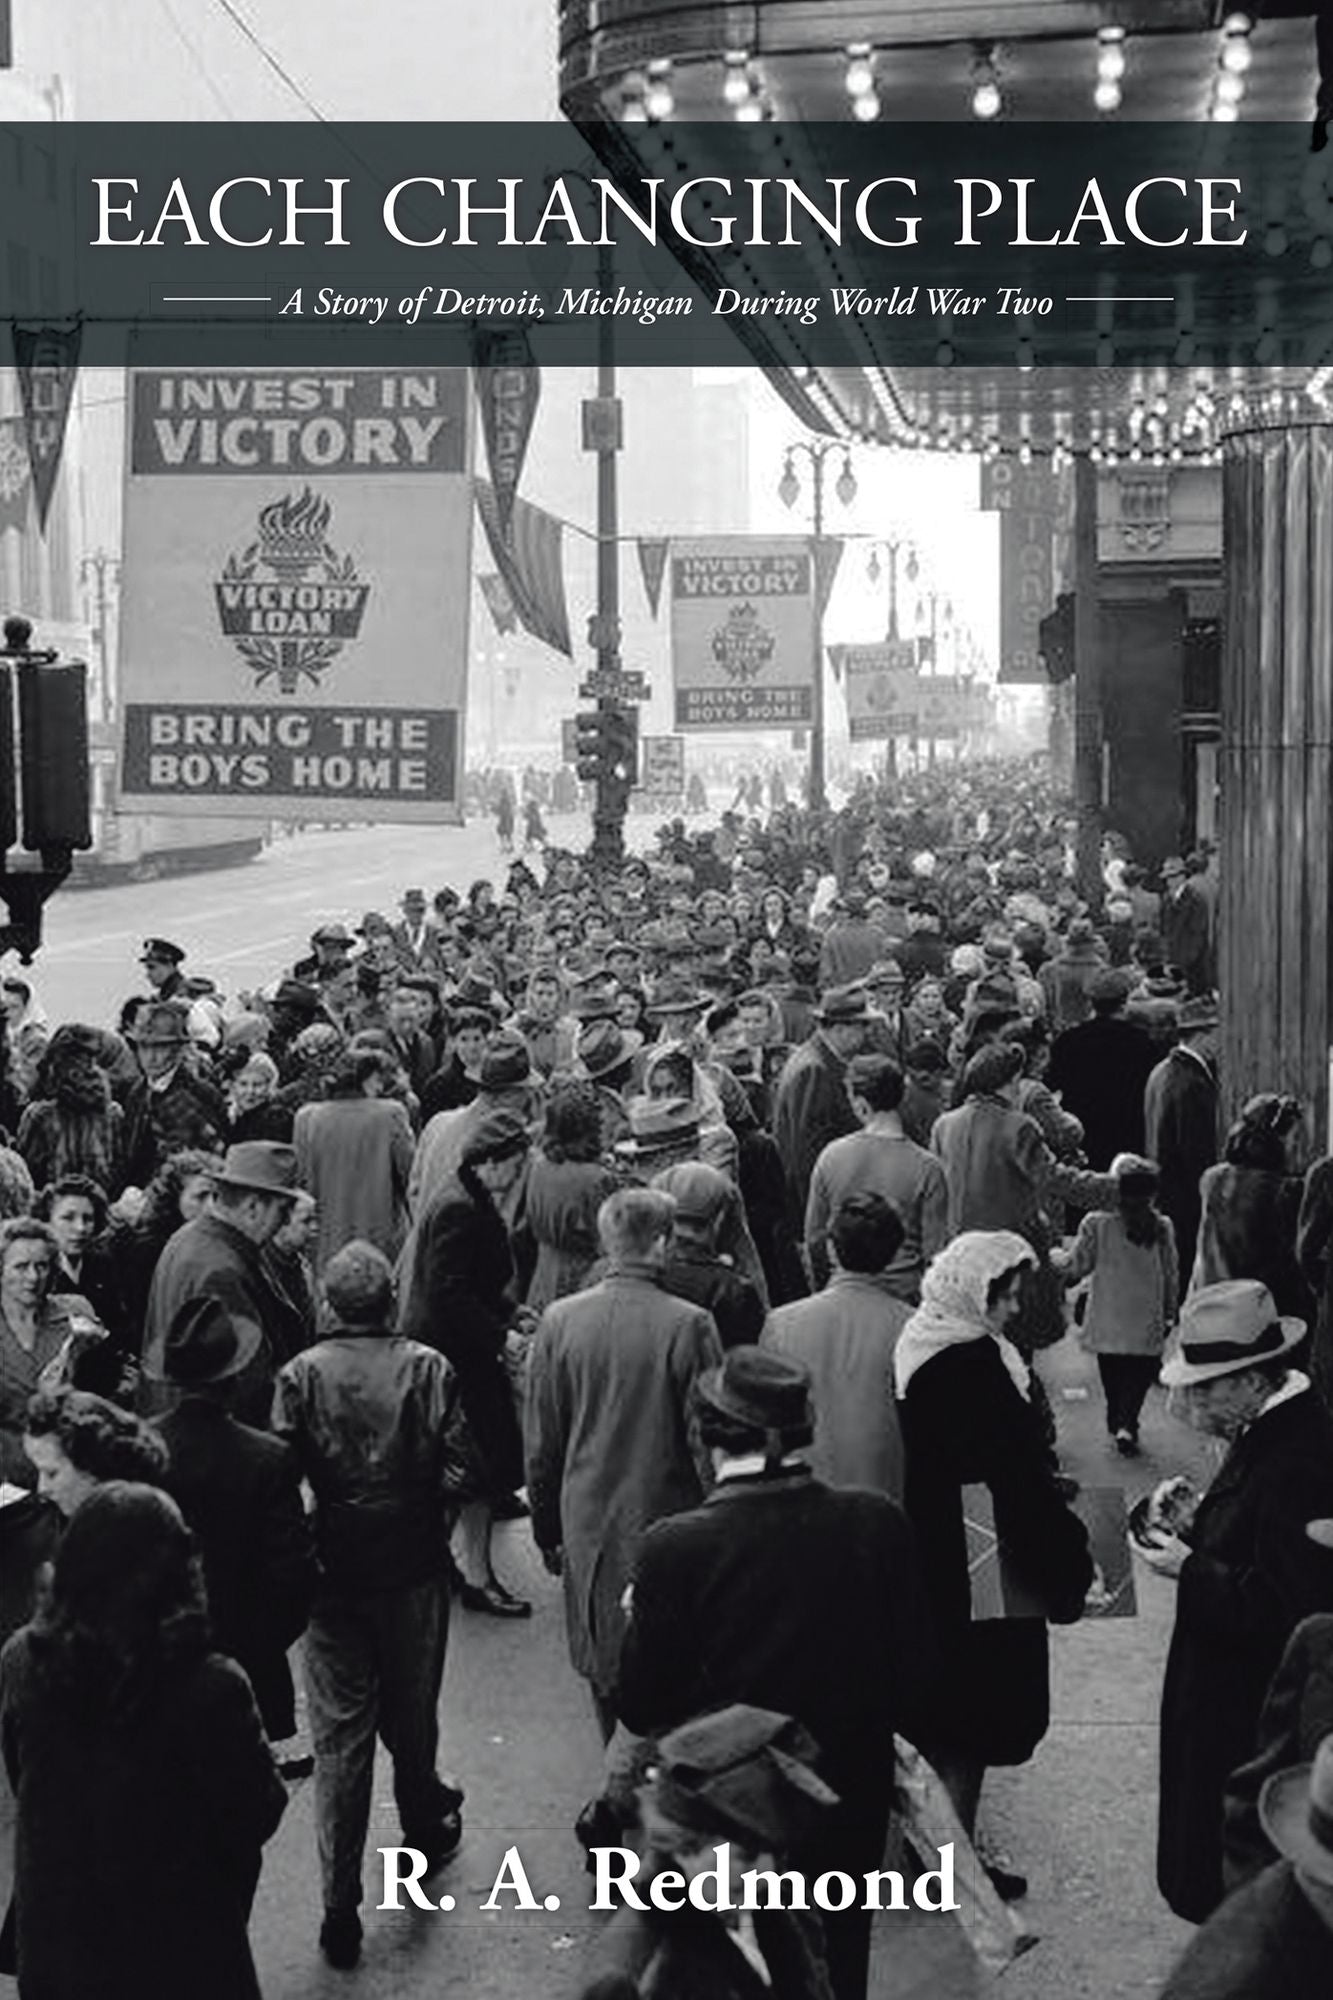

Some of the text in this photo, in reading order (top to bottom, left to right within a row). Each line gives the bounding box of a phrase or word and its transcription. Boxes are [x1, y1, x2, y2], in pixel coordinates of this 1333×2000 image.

[158, 375, 438, 411] INVEST IN
[153, 416, 449, 466] VICTORY
[221, 584, 362, 611] VICTORY
[682, 572, 800, 595] VICTORY
[251, 610, 333, 634] LOAN
[151, 713, 429, 750] BRING THE
[150, 753, 427, 791] BOYS HOME
